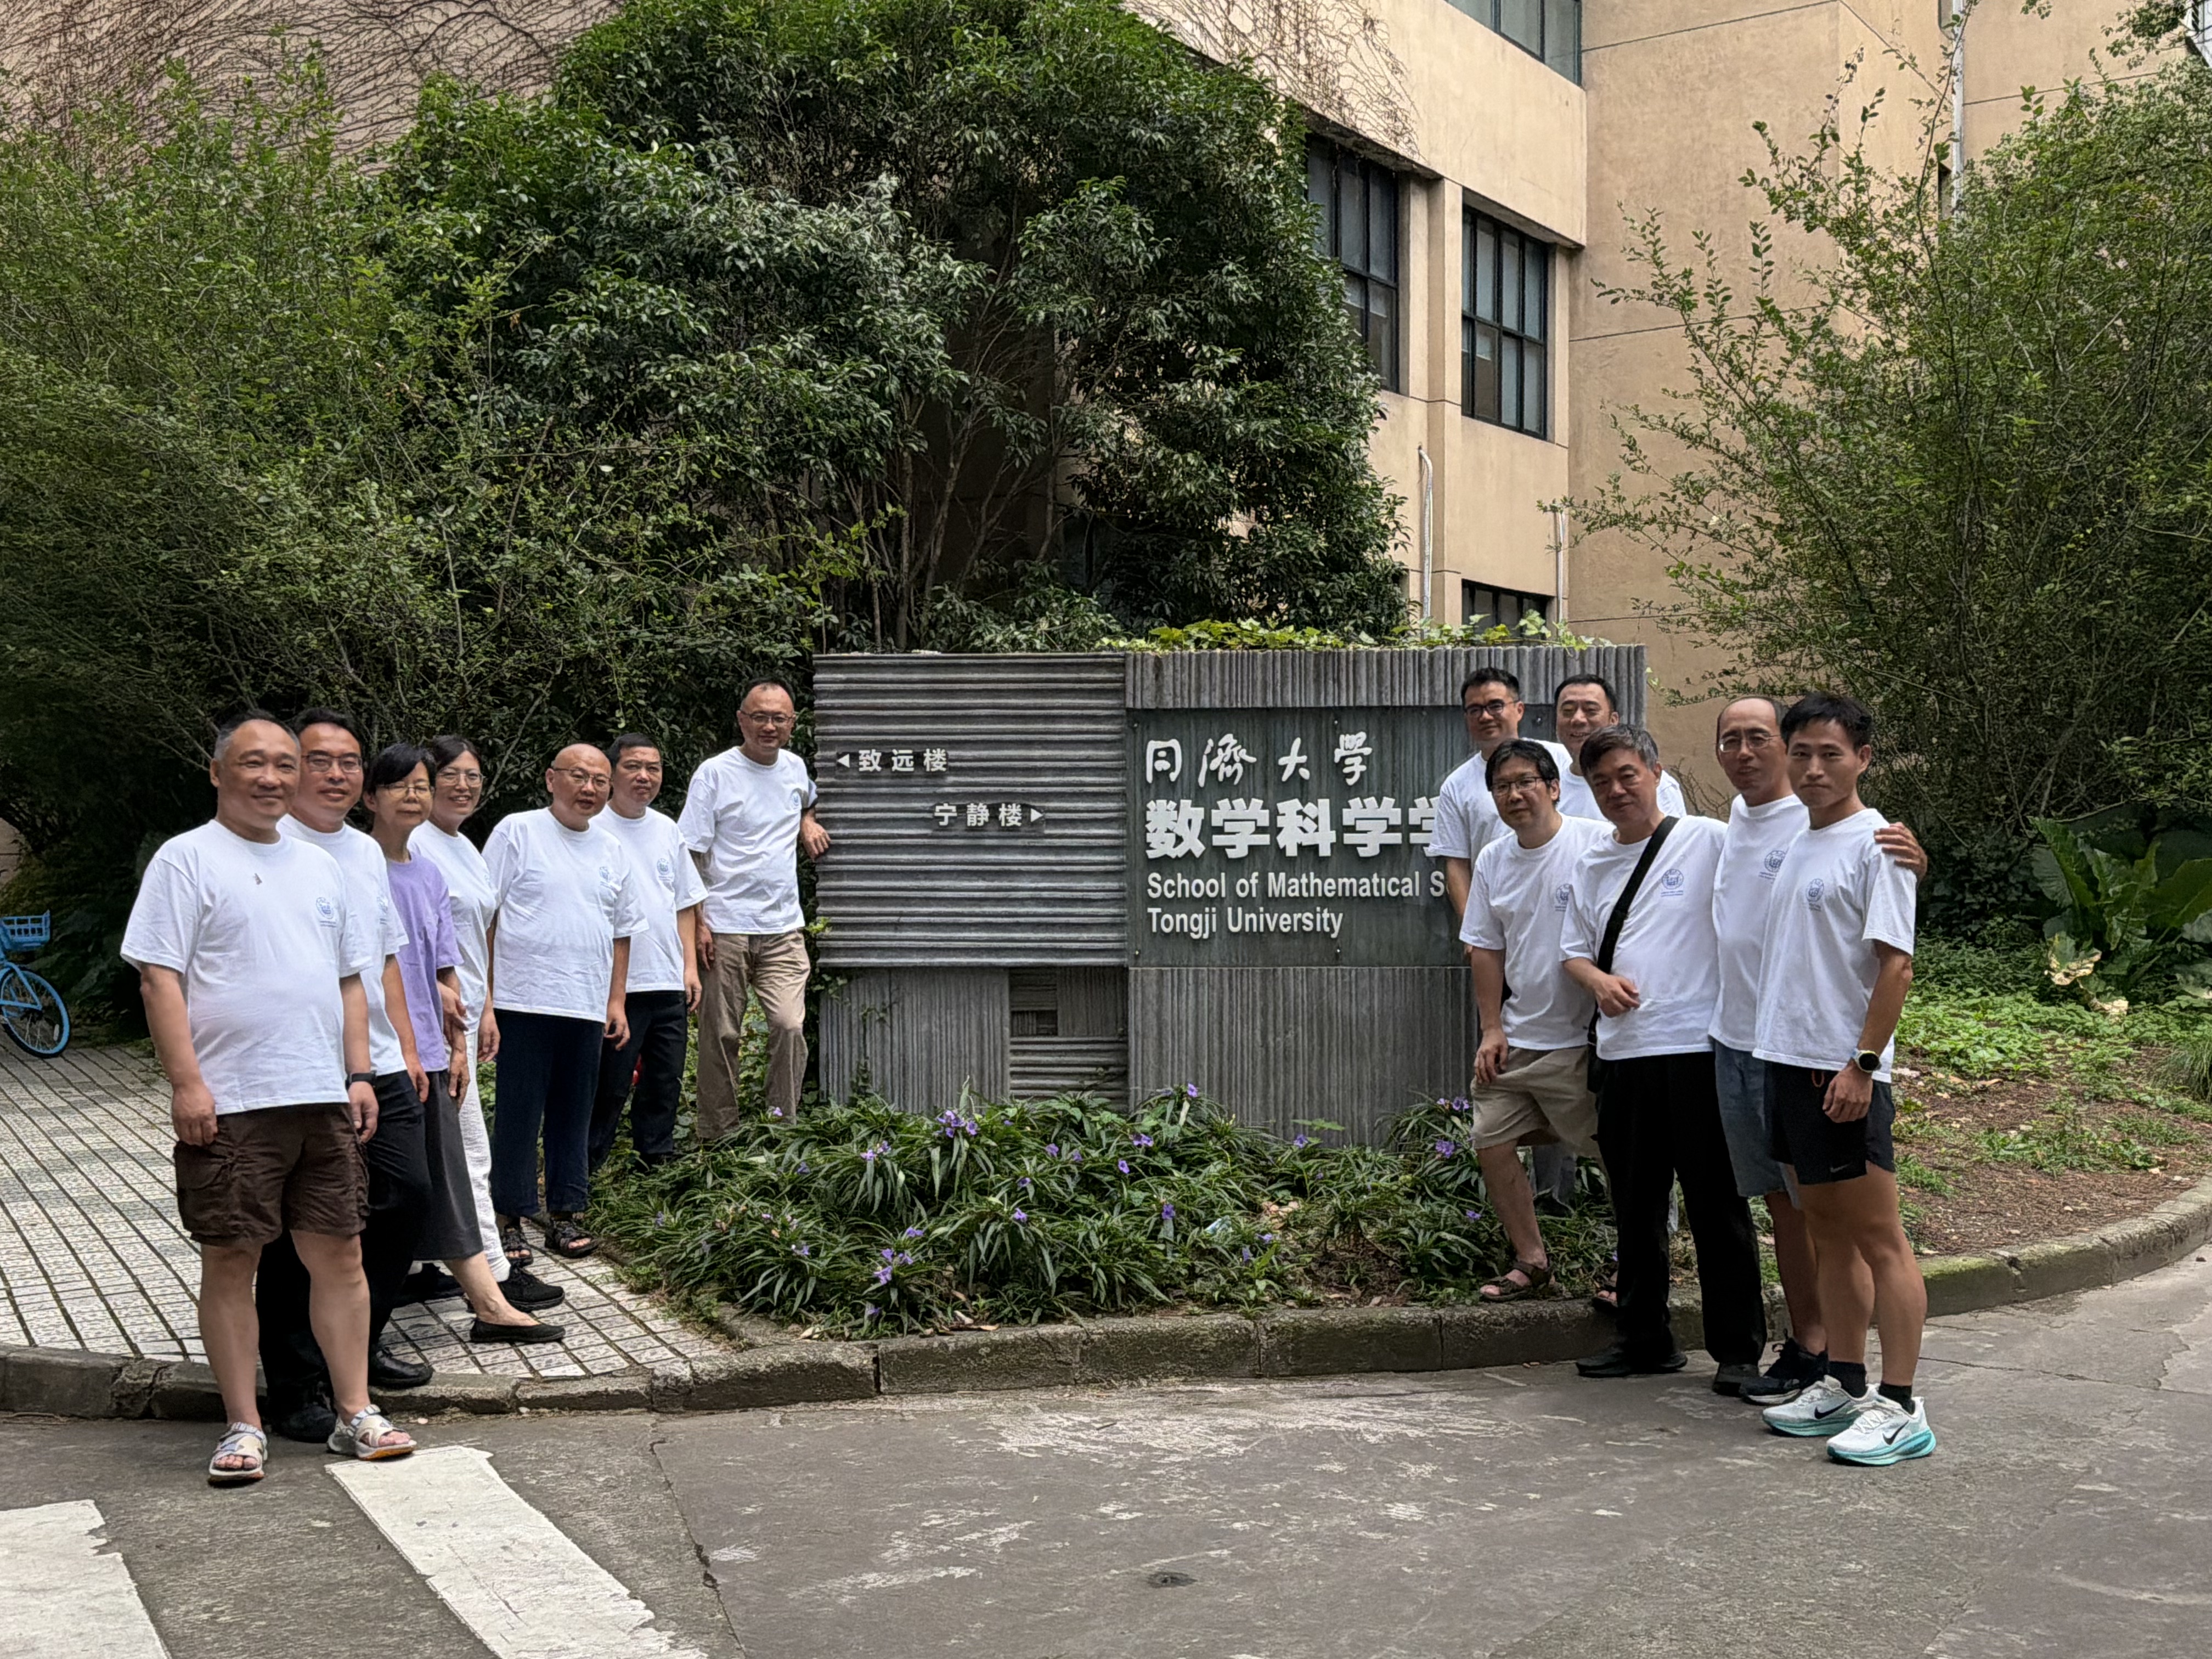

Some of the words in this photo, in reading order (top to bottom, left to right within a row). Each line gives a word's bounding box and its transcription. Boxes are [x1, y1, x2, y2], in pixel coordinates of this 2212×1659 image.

[859, 749, 947, 771] 致远楼
[934, 802, 1022, 826] 宁静楼
[1147, 872, 1226, 898] School
[1235, 872, 1259, 898] of
[1268, 871, 1419, 897] Mathematical
[1430, 871, 1449, 897] S
[1147, 907, 1216, 939] Tongji
[1227, 907, 1343, 938] University
